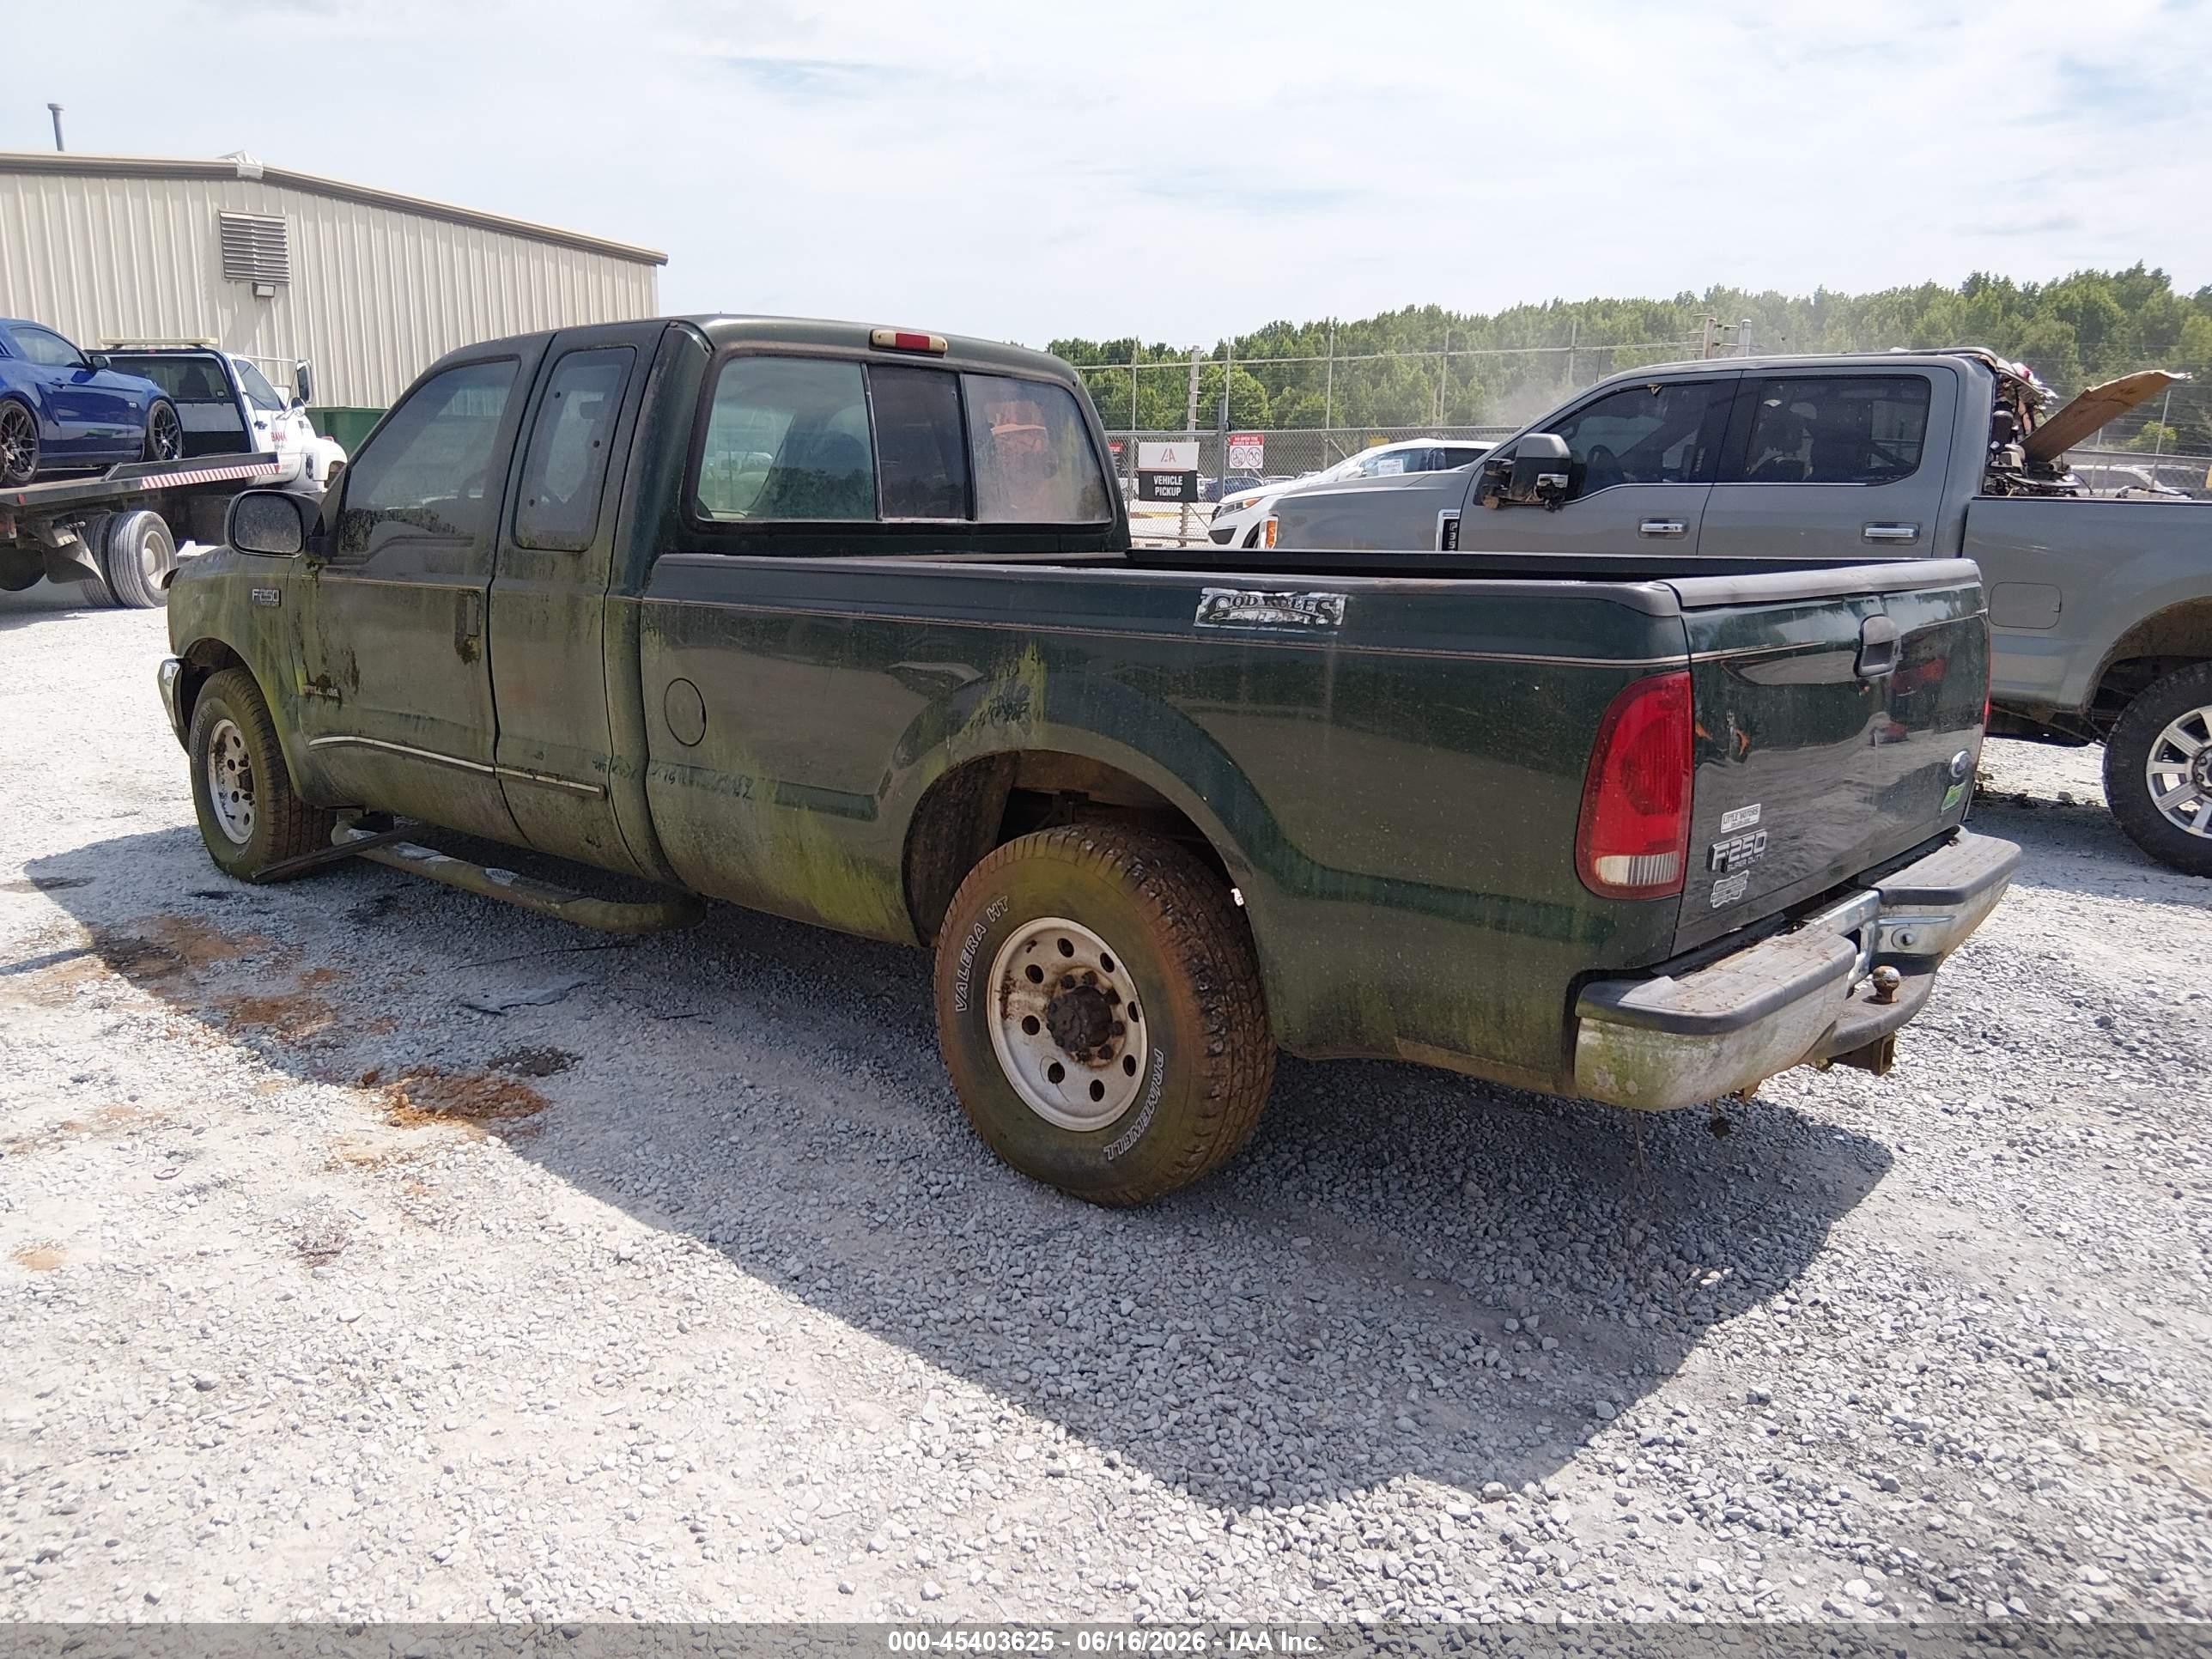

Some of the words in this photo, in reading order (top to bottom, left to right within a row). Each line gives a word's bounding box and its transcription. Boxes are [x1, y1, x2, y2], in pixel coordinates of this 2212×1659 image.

[1153, 475, 1183, 486] VEHICLE
[1155, 486, 1182, 496] PICKUP
[252, 588, 280, 603] F250
[1711, 830, 1768, 870] F250
[955, 921, 988, 1012] VALERA
[986, 895, 1009, 923] HT
[1103, 1048, 1164, 1161] PRIMEWELL
